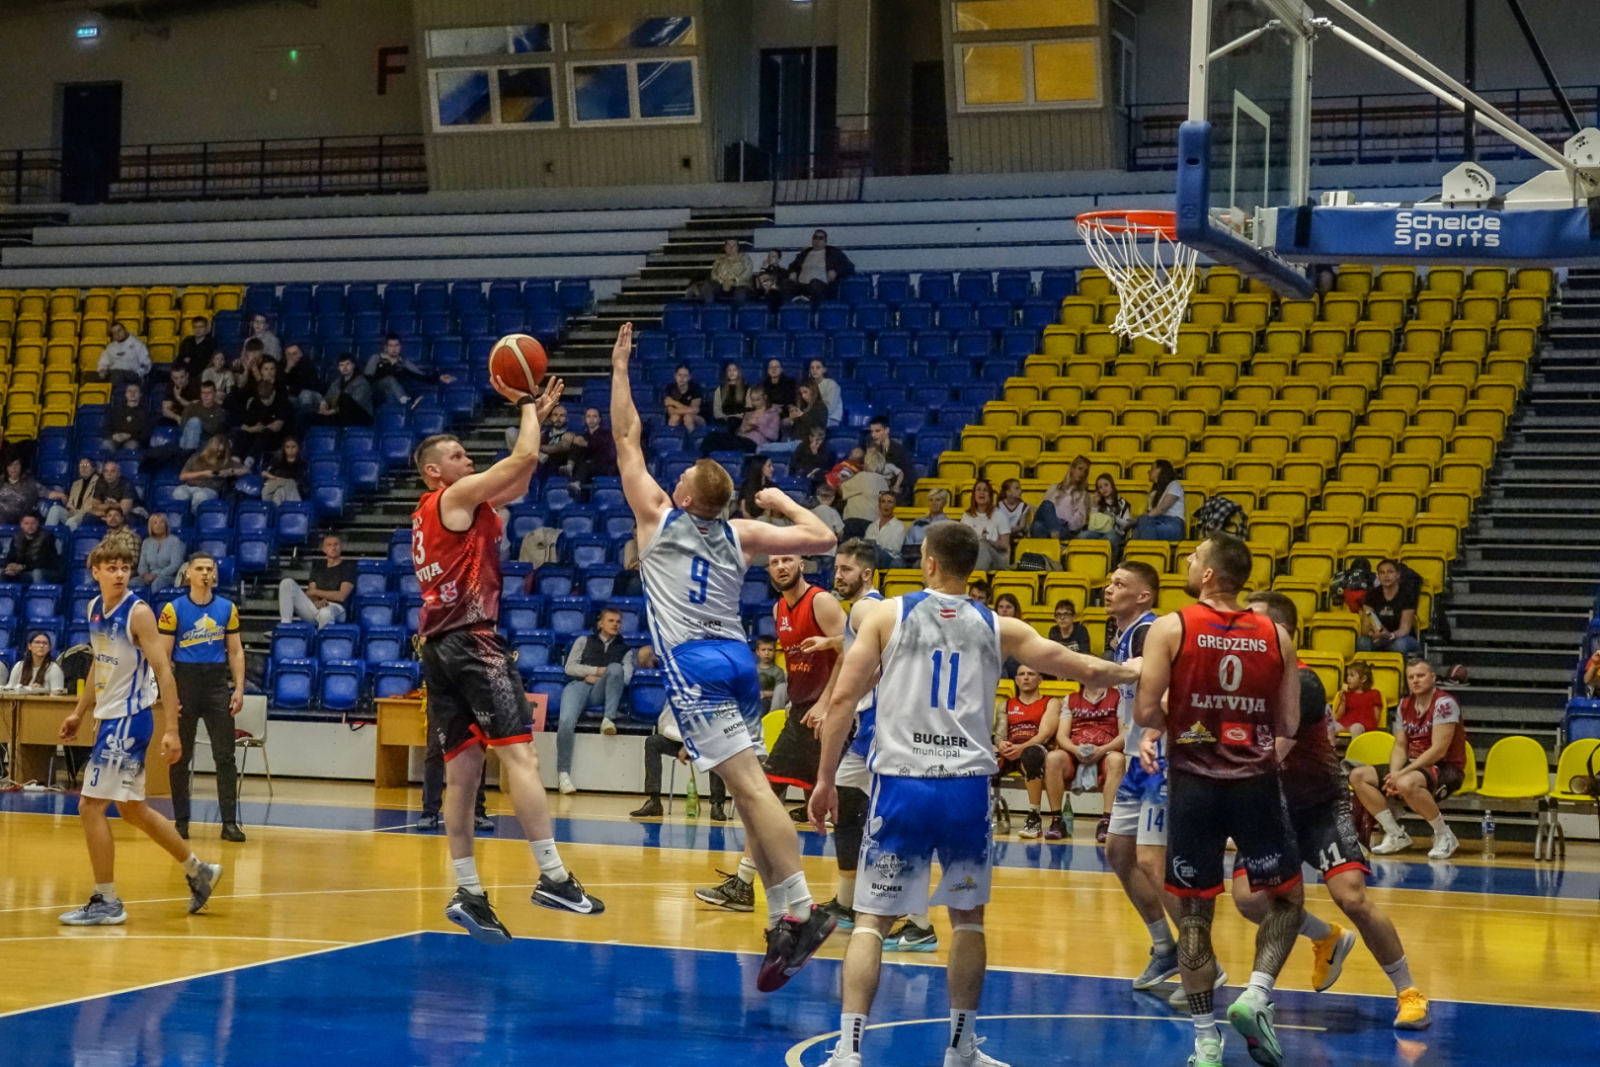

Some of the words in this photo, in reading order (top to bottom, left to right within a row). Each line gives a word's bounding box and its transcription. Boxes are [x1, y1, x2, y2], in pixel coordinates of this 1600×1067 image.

[377, 46, 408, 95] F
[1395, 212, 1501, 230] Schelde
[1394, 229, 1500, 250] Sports
[415, 561, 444, 582] VIJA
[689, 556, 710, 604] 9
[1198, 634, 1267, 652] GREDZENS
[931, 650, 960, 711] 11
[1219, 654, 1242, 692] 0
[1191, 693, 1266, 714] LATVIJA
[913, 732, 968, 748] BUCHER
[912, 747, 961, 759] municipal
[90, 767, 100, 787] 3
[1146, 807, 1165, 833] 14
[1319, 842, 1346, 871] 41
[872, 882, 903, 892] BUCHER
